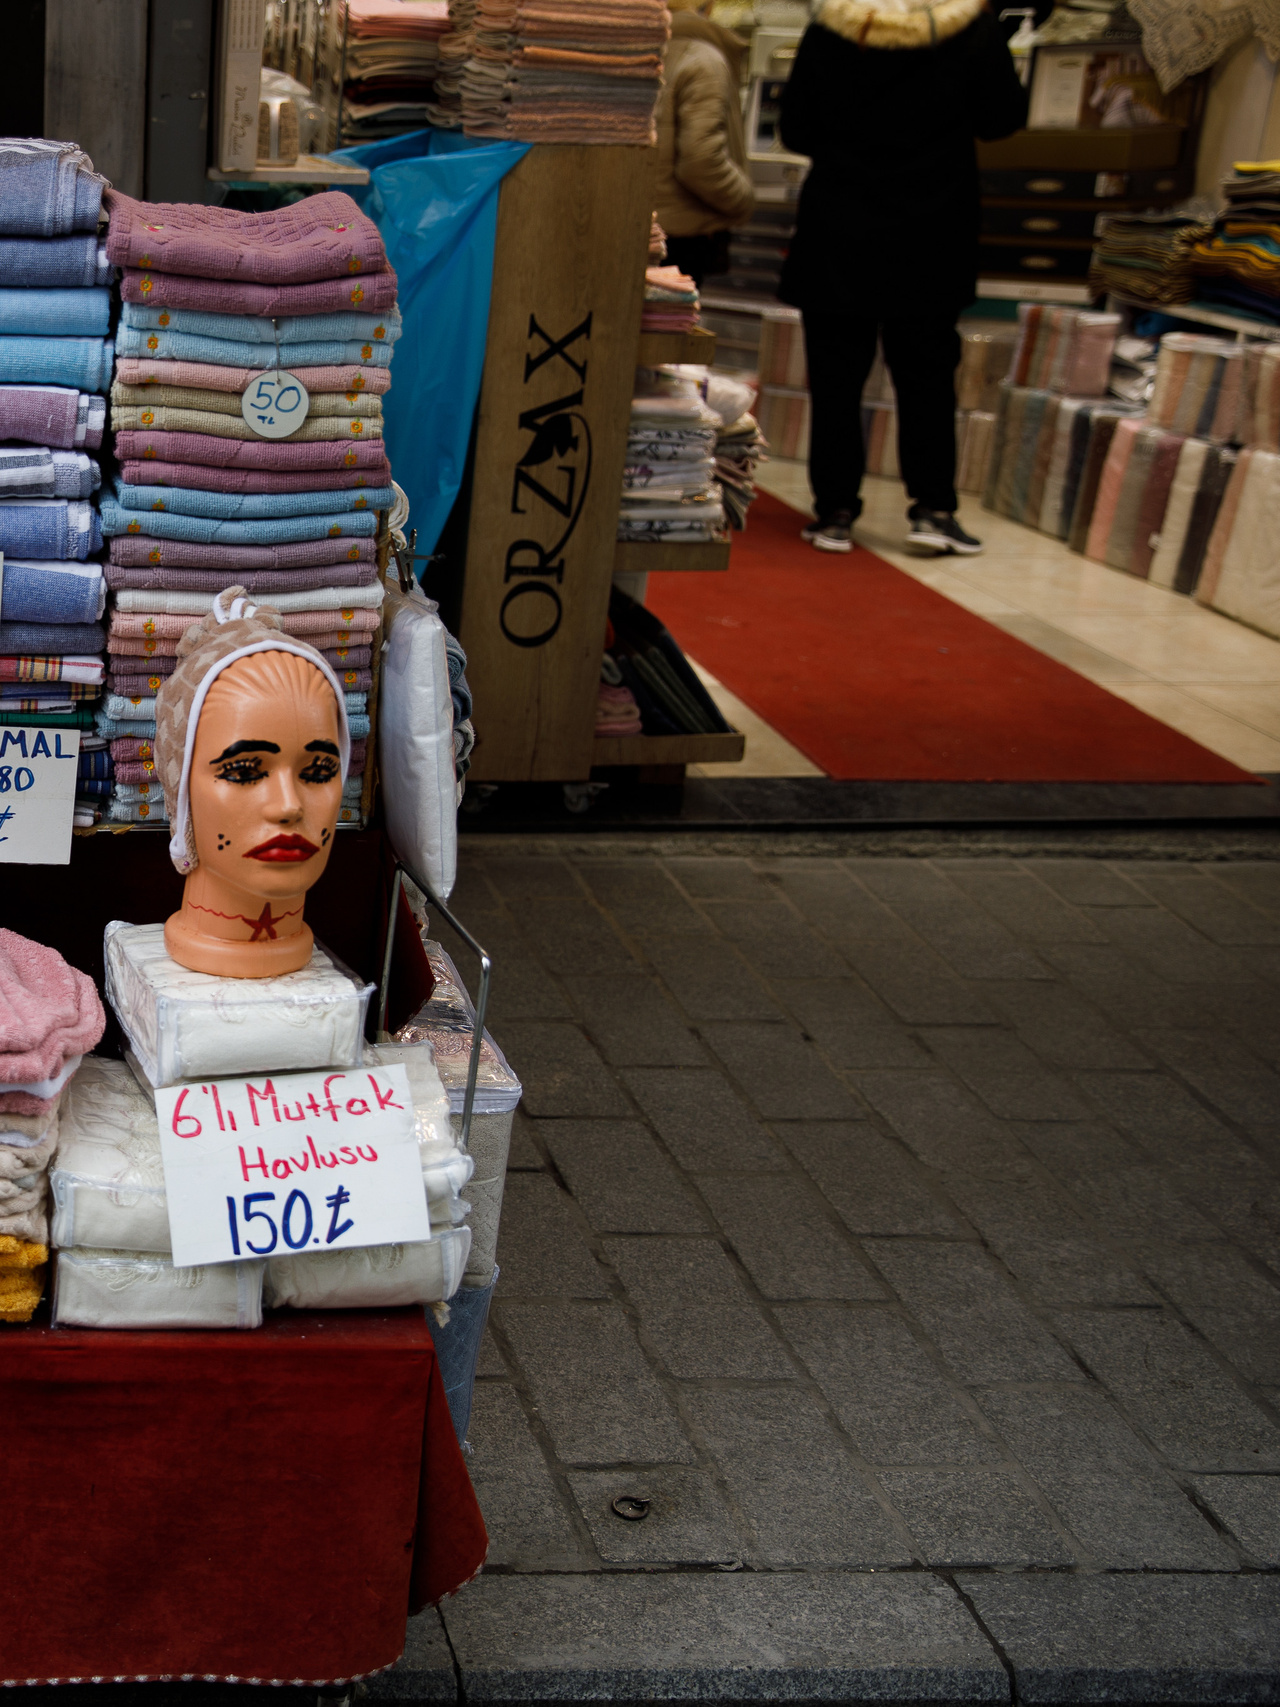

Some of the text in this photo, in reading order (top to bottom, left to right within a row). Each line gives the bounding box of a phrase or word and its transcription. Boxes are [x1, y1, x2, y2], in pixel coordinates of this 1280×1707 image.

[250, 381, 301, 413] 50
[246, 1074, 405, 1127] Mutfak
[238, 1135, 379, 1182] Havlusu
